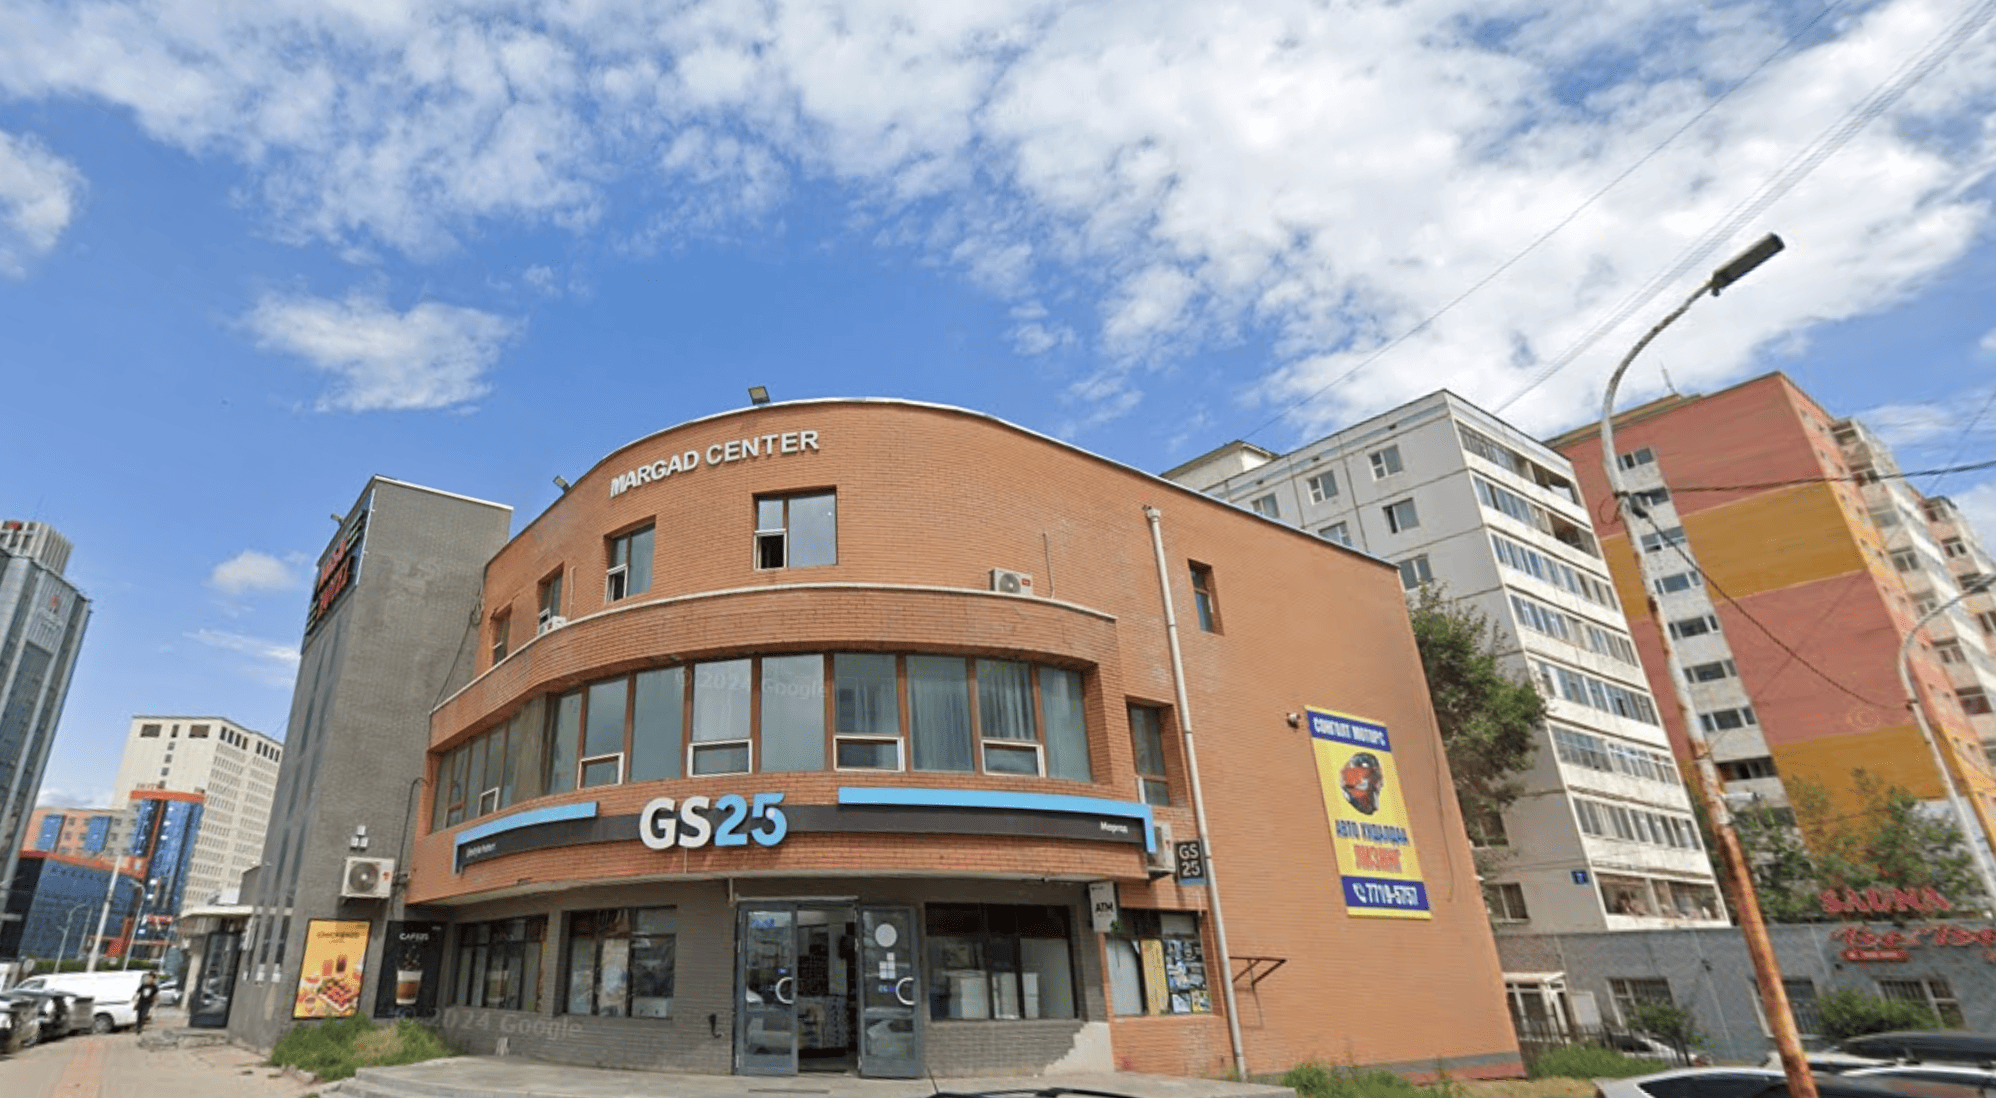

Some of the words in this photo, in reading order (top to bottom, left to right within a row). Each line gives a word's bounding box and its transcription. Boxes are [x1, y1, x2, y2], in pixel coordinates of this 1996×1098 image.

[610, 450, 699, 498] MARGAD
[705, 430, 820, 466] CENTER
[639, 792, 788, 849] GS25
[1178, 843, 1199, 860] GS
[1181, 861, 1200, 877] 25
[1095, 901, 1113, 913] ATM
[1819, 886, 1951, 914] SAUNA
